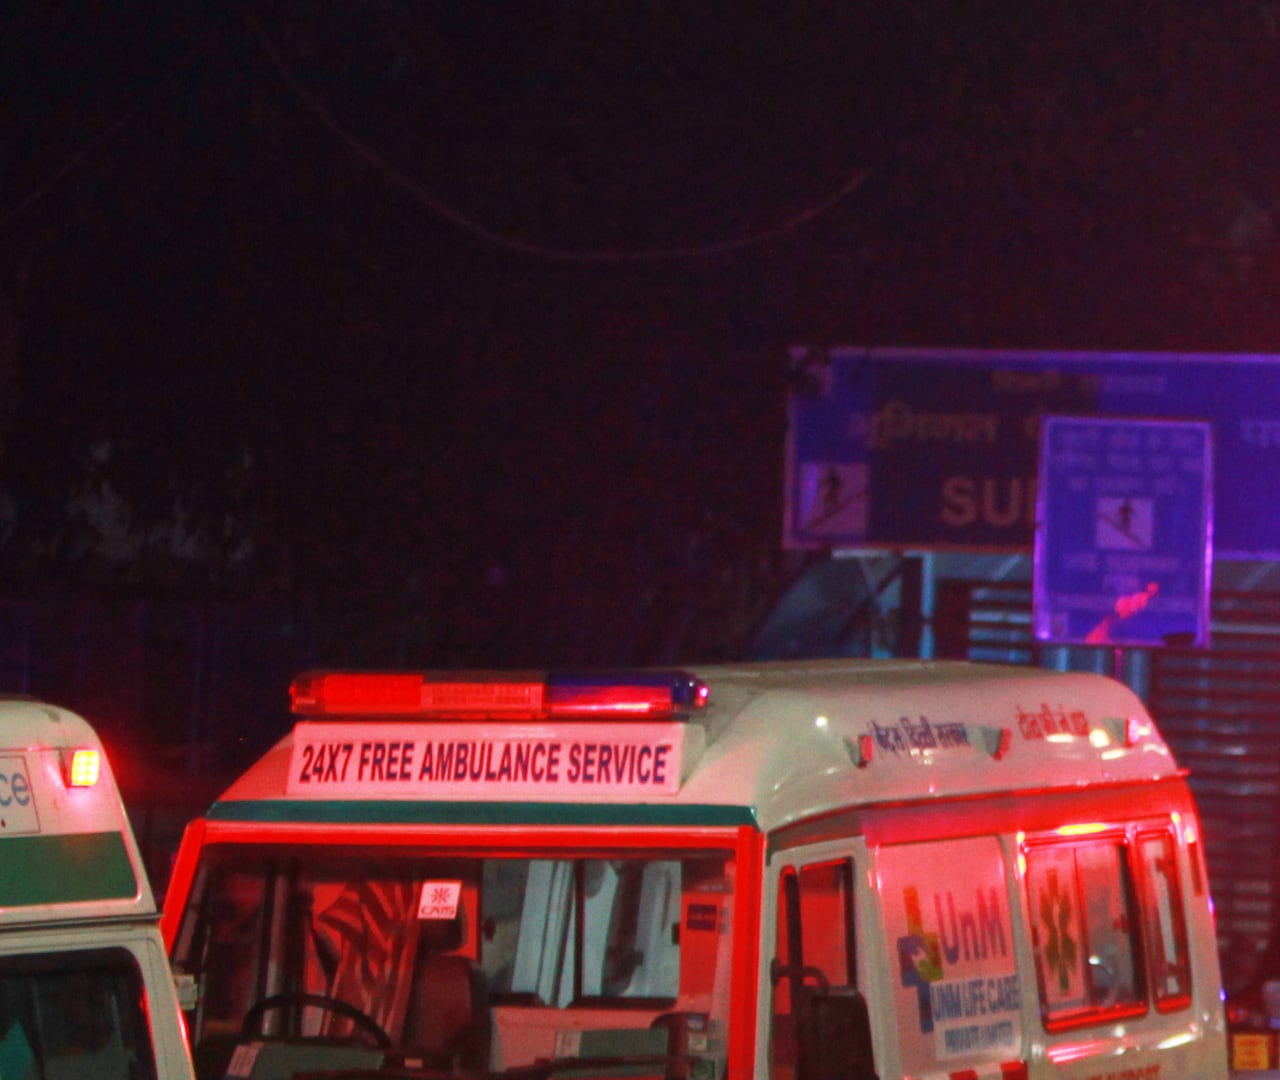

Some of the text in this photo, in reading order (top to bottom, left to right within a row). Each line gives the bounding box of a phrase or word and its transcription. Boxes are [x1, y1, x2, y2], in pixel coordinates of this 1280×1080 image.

[299, 743, 671, 784] 24X7 FREE AMBULANCE SERVICE
